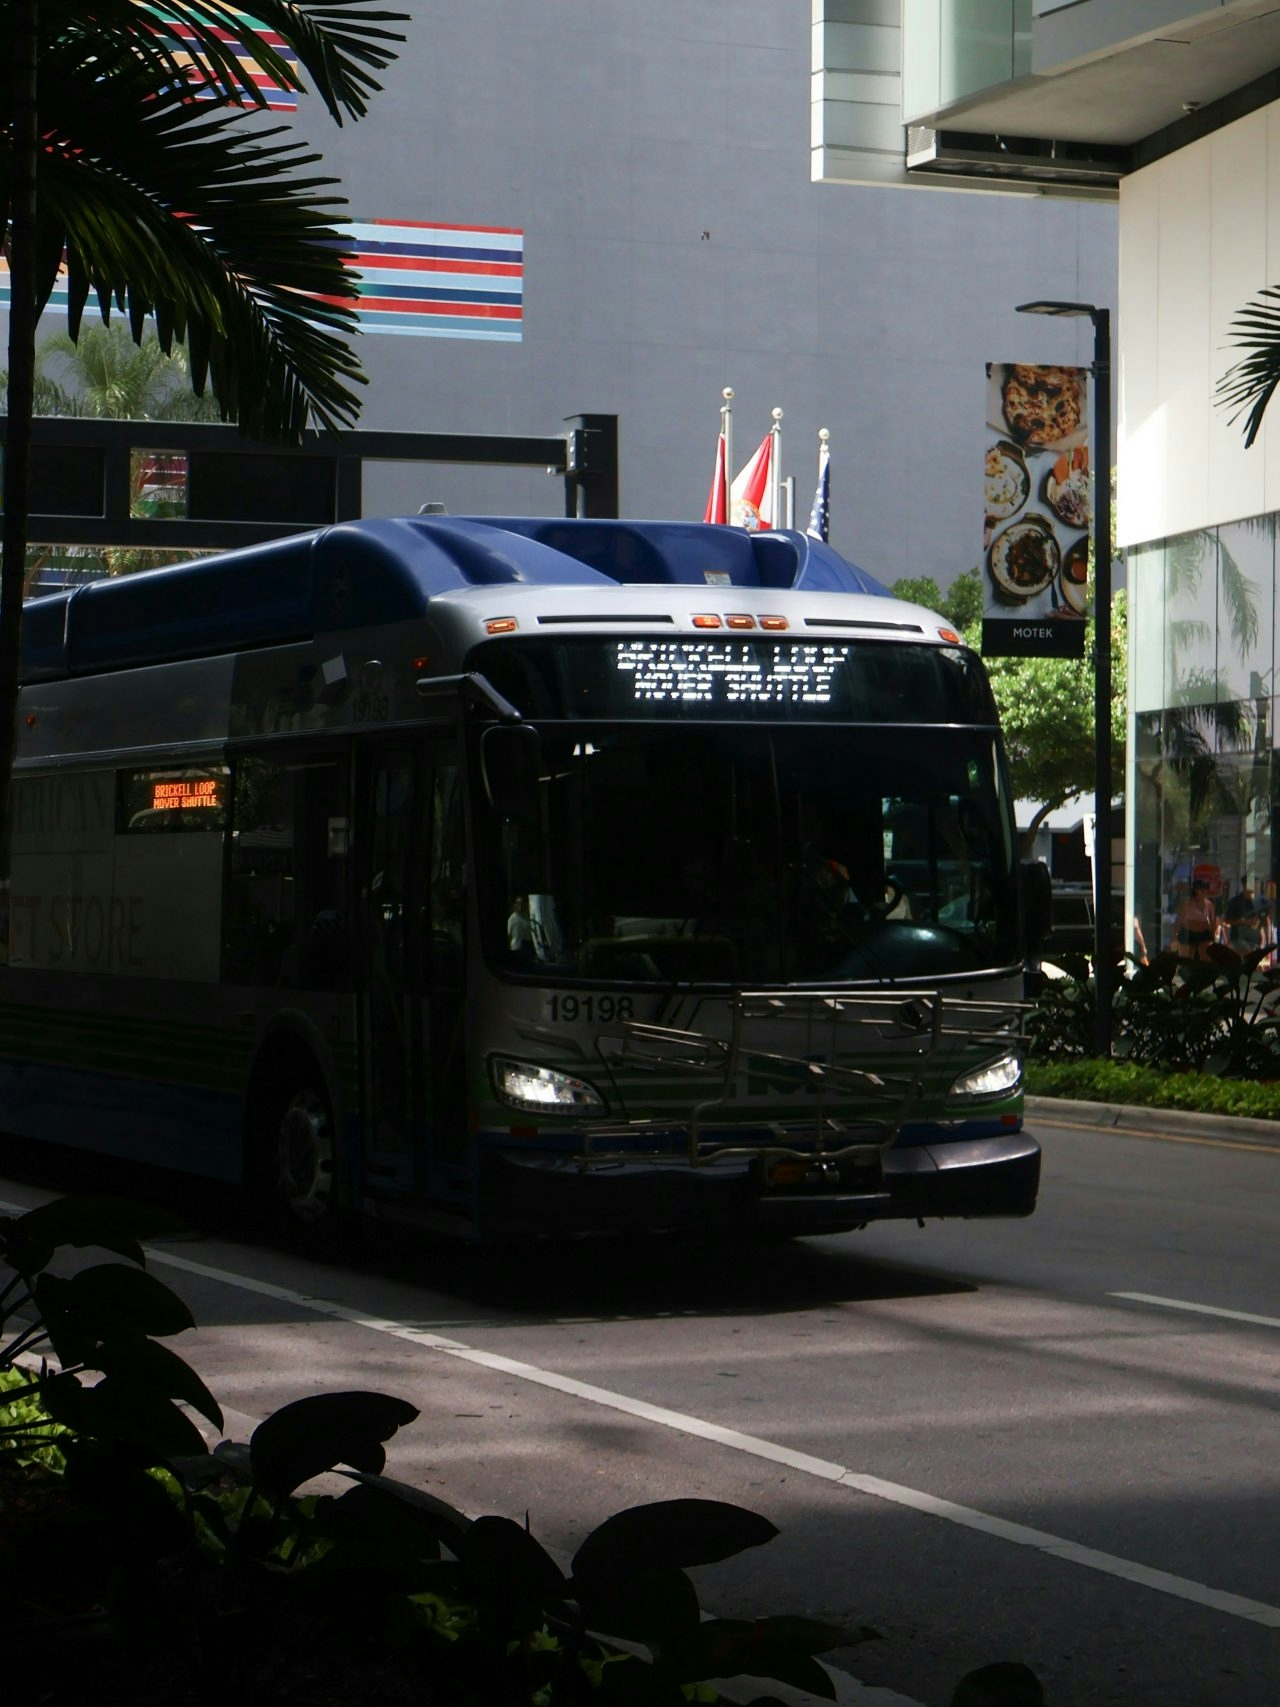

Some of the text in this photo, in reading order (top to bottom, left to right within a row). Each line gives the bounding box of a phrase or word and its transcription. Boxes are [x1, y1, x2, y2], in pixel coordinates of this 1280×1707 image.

[1013, 628, 1053, 638] MOTEK
[154, 781, 216, 798] BRICKELL LOOP
[153, 795, 217, 810] MOVER SHUTTLE
[546, 995, 634, 1023] 19198
